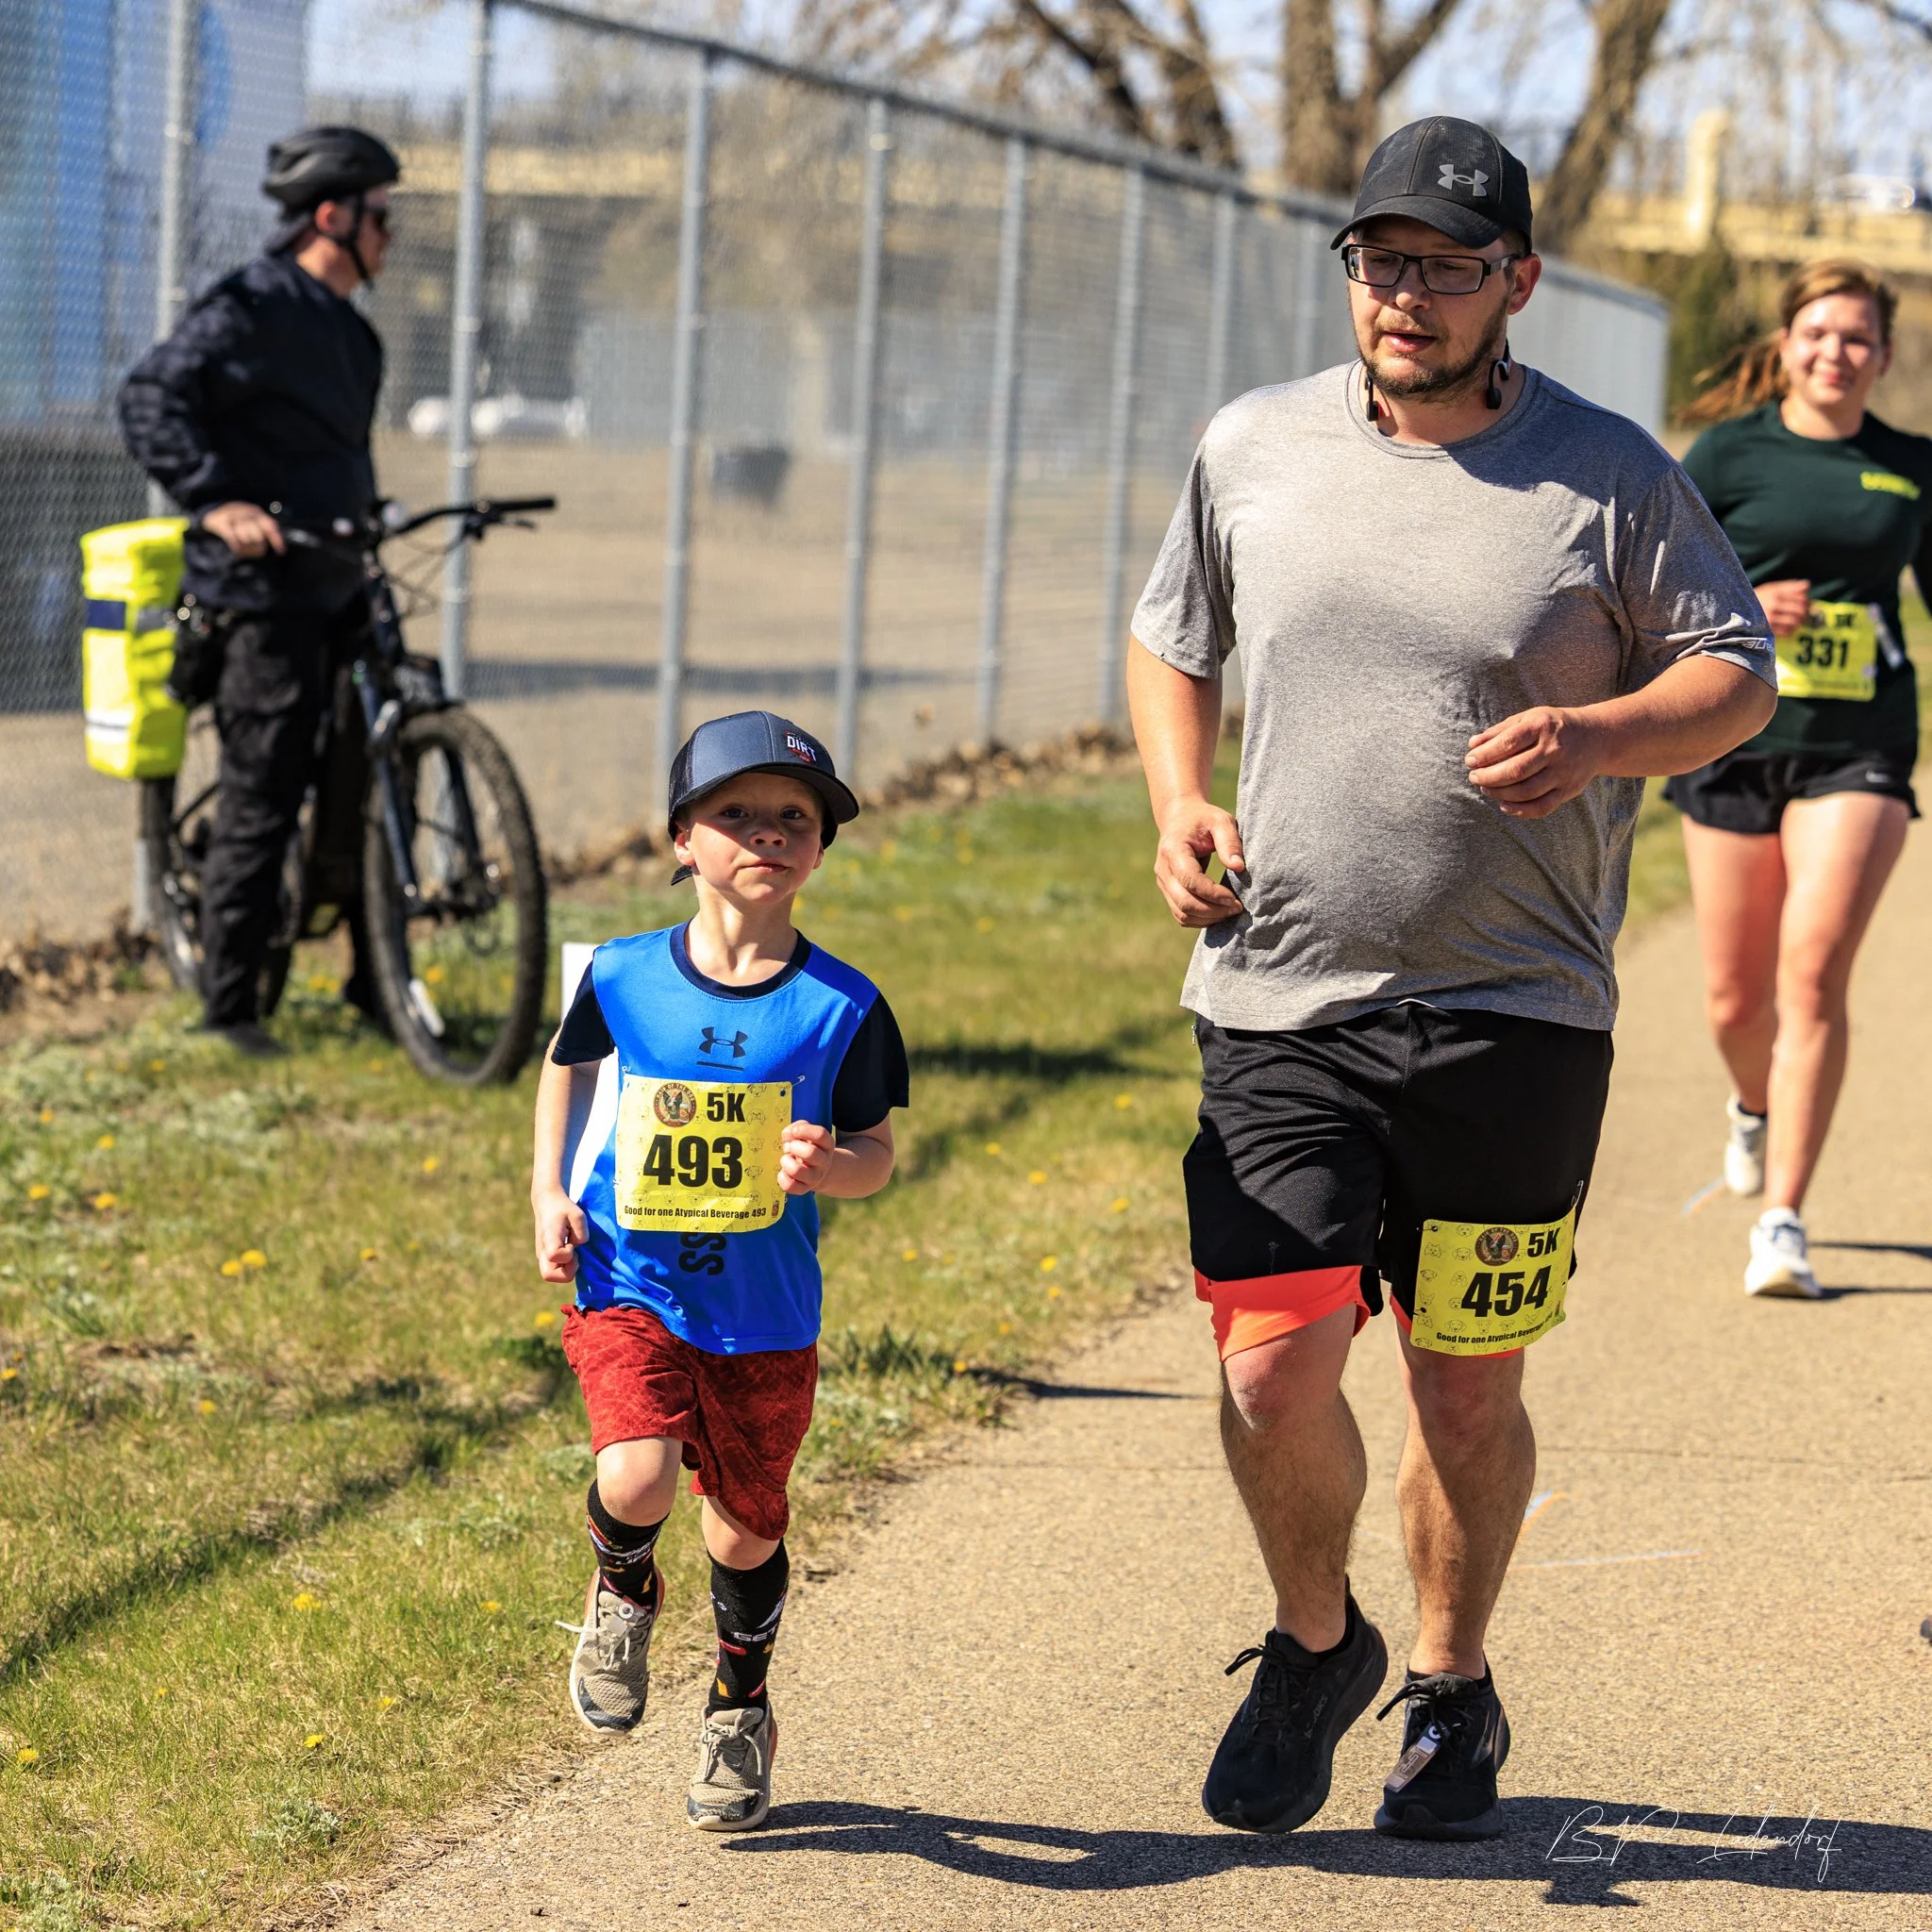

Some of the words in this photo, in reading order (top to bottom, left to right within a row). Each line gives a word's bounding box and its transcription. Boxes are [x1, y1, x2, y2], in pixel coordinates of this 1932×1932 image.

[1796, 633, 1850, 671] 331
[787, 736, 816, 761] DIRT
[708, 1092, 746, 1123] 5K
[643, 1134, 742, 1189] 493
[625, 1205, 642, 1216] Good
[644, 1207, 657, 1216] for
[658, 1208, 674, 1217] one
[675, 1208, 708, 1218] Atypical
[710, 1209, 750, 1220] Beverage
[751, 1208, 767, 1218] 493
[1526, 1227, 1561, 1257] 5K
[1462, 1265, 1552, 1318] 454
[1436, 1332, 1457, 1343] Good
[1457, 1335, 1471, 1343] for
[1487, 1331, 1518, 1343] Atypical
